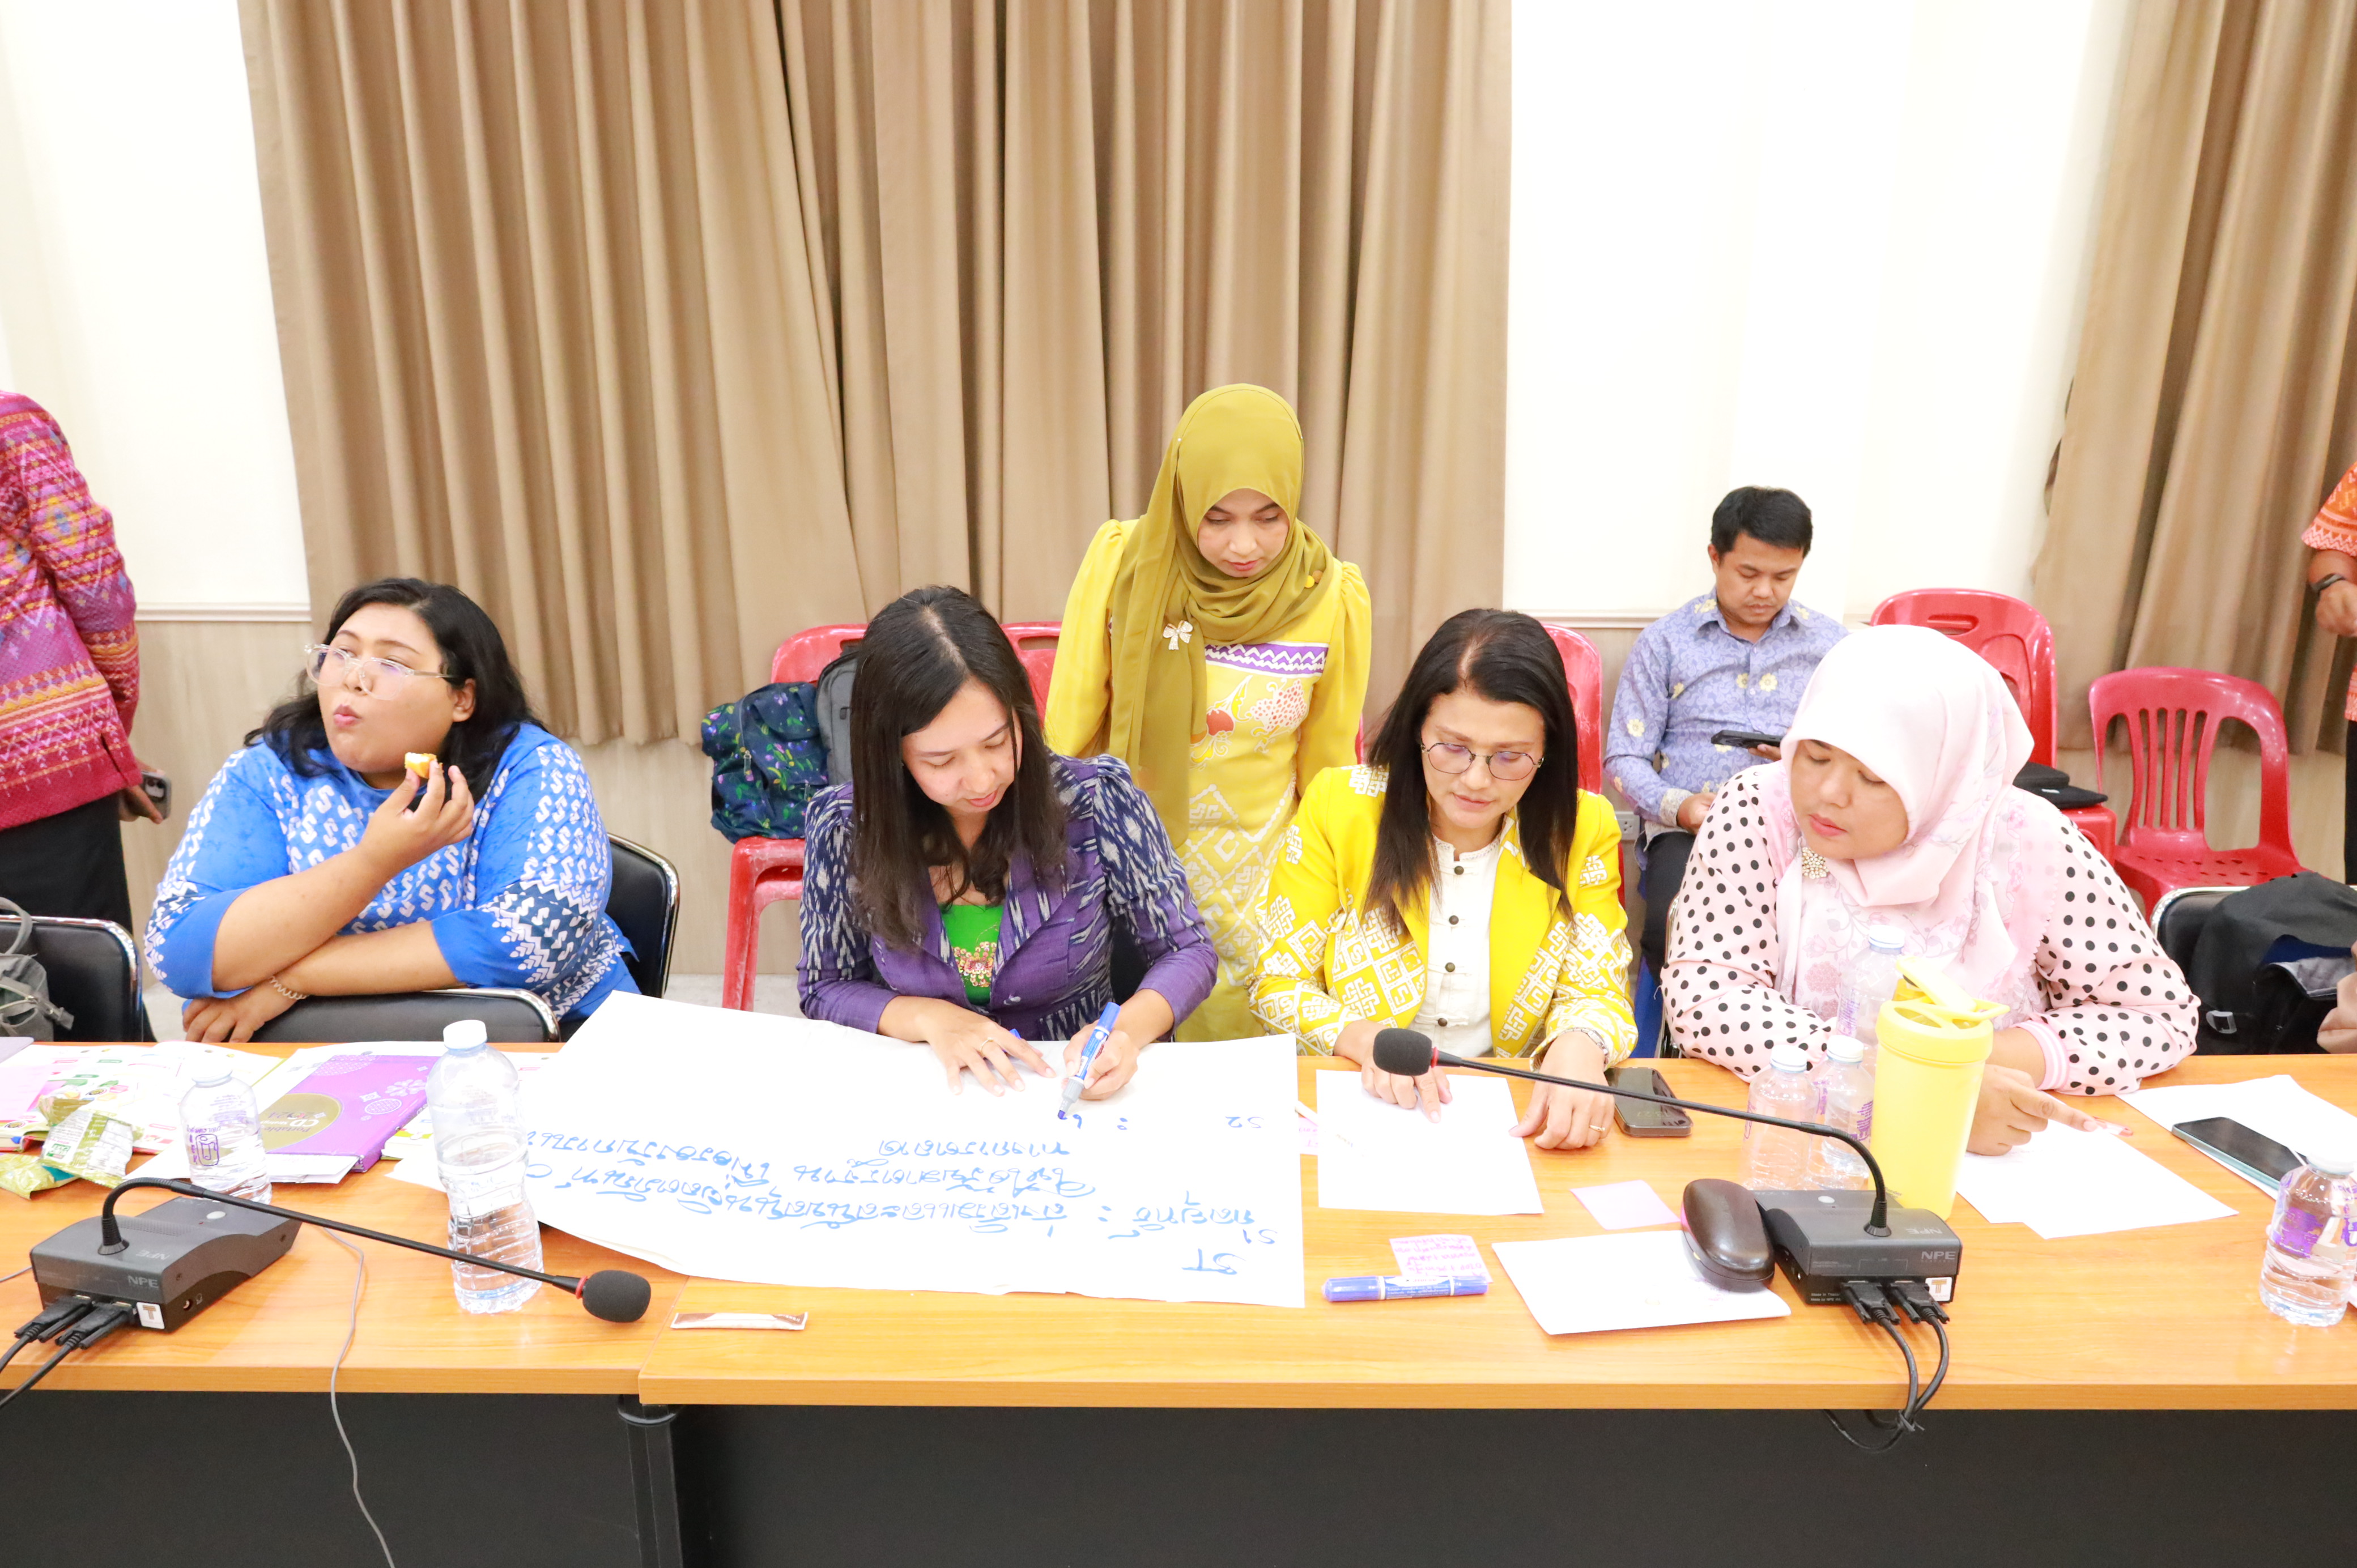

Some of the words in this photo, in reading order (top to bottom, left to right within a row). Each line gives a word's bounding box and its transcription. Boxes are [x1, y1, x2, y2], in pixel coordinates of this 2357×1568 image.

[879, 1140, 1070, 1157] ทางการตลาด
[136, 1250, 170, 1260] NPE
[1921, 1251, 1956, 1260] NPE
[127, 1275, 159, 1289] NPE
